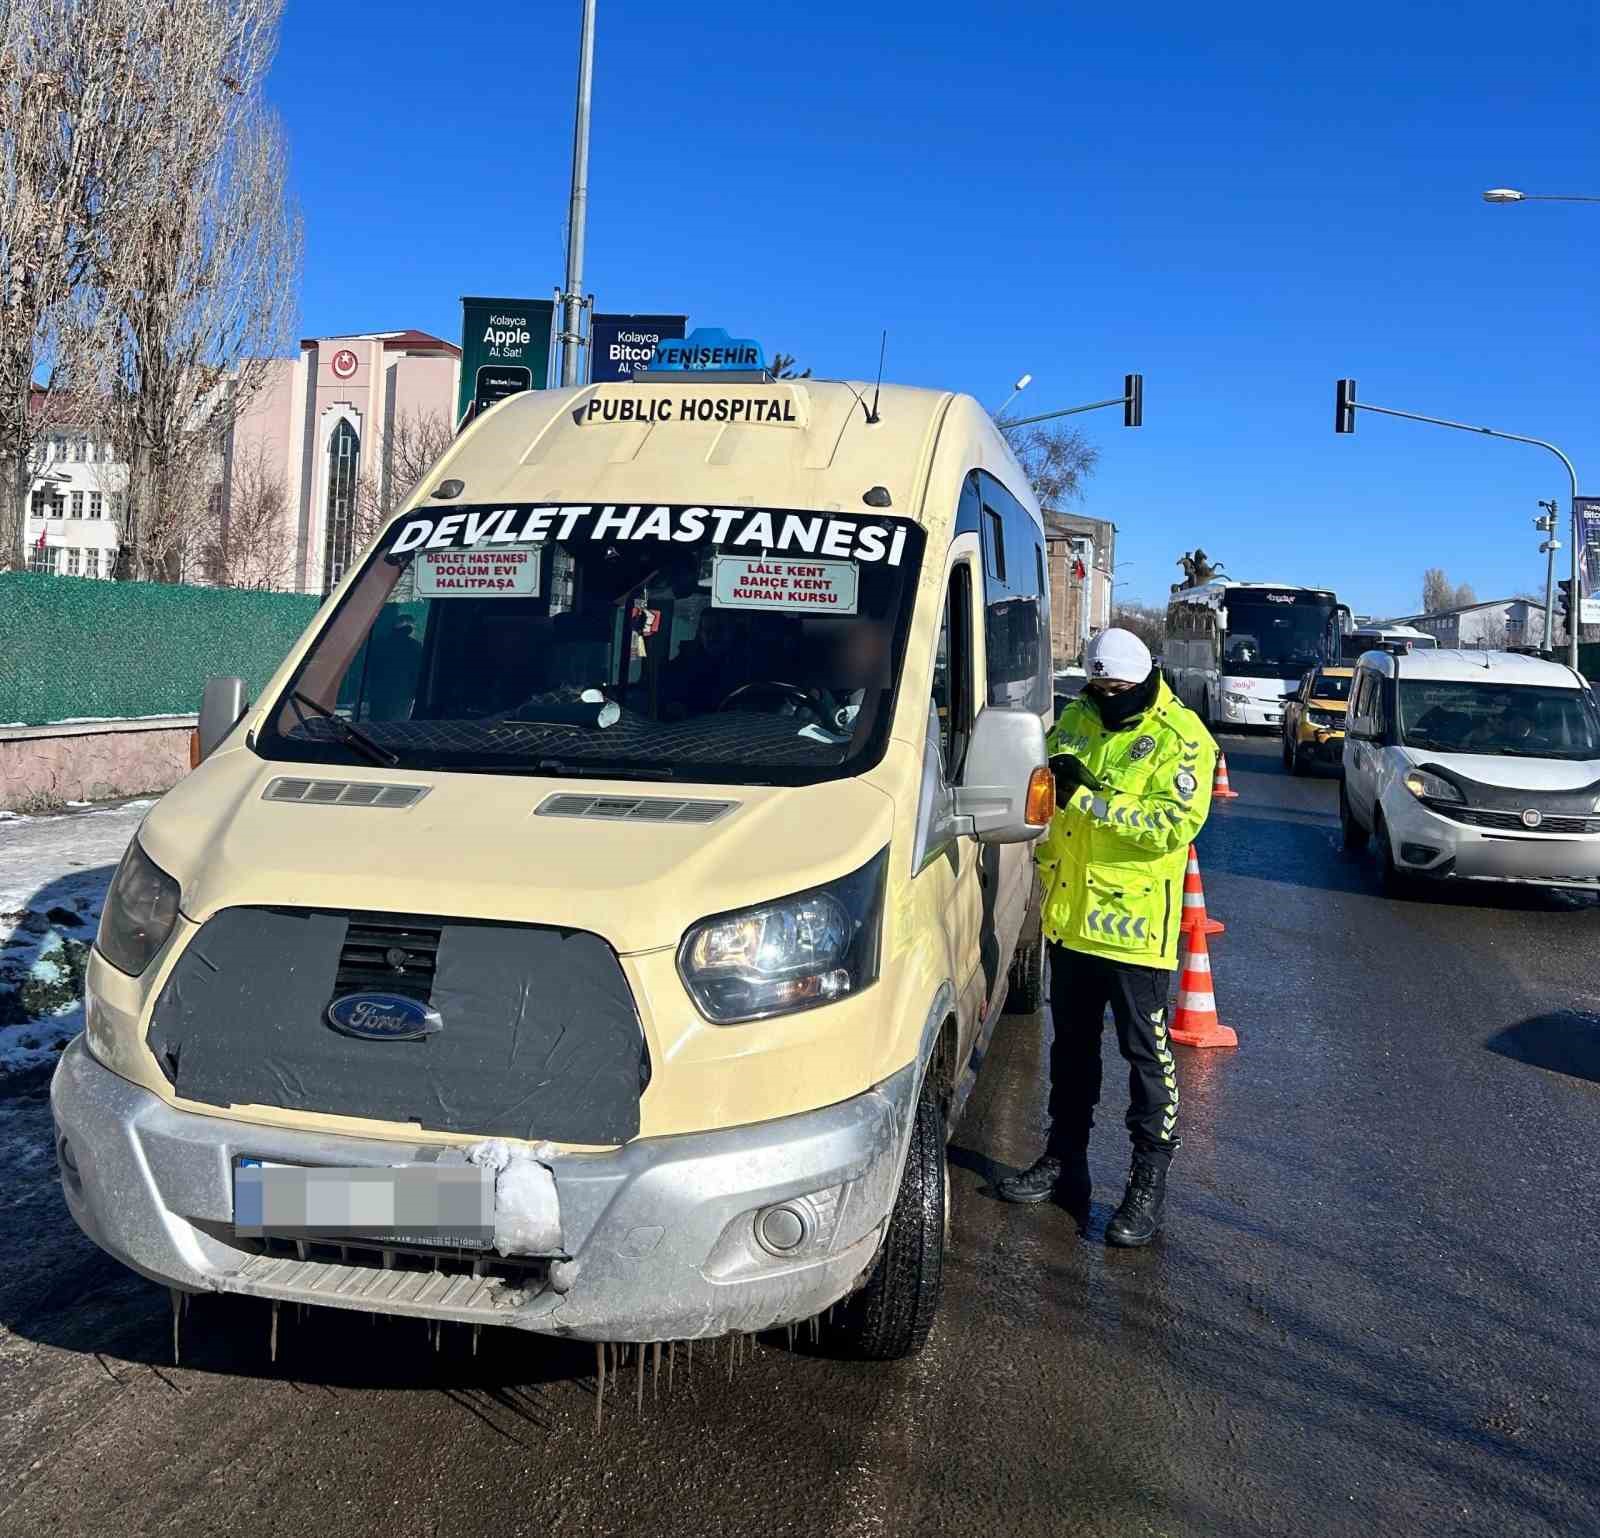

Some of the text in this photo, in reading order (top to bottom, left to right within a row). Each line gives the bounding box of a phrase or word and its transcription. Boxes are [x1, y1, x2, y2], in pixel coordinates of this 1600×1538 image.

[490, 315, 526, 327] Kolayca
[483, 327, 530, 346] Apple
[618, 331, 658, 345] Kolayca
[610, 344, 656, 361] Bitcoi
[587, 399, 796, 421] PUBLIC HOSPITAL
[389, 506, 907, 566] DEVLET HASTANESİ
[427, 553, 466, 563] DEVLET
[787, 566, 826, 577] KENT
[740, 576, 832, 590] BAHÇE KENT
[733, 588, 838, 603] KURAN KURSU
[349, 1001, 409, 1030] Ford
